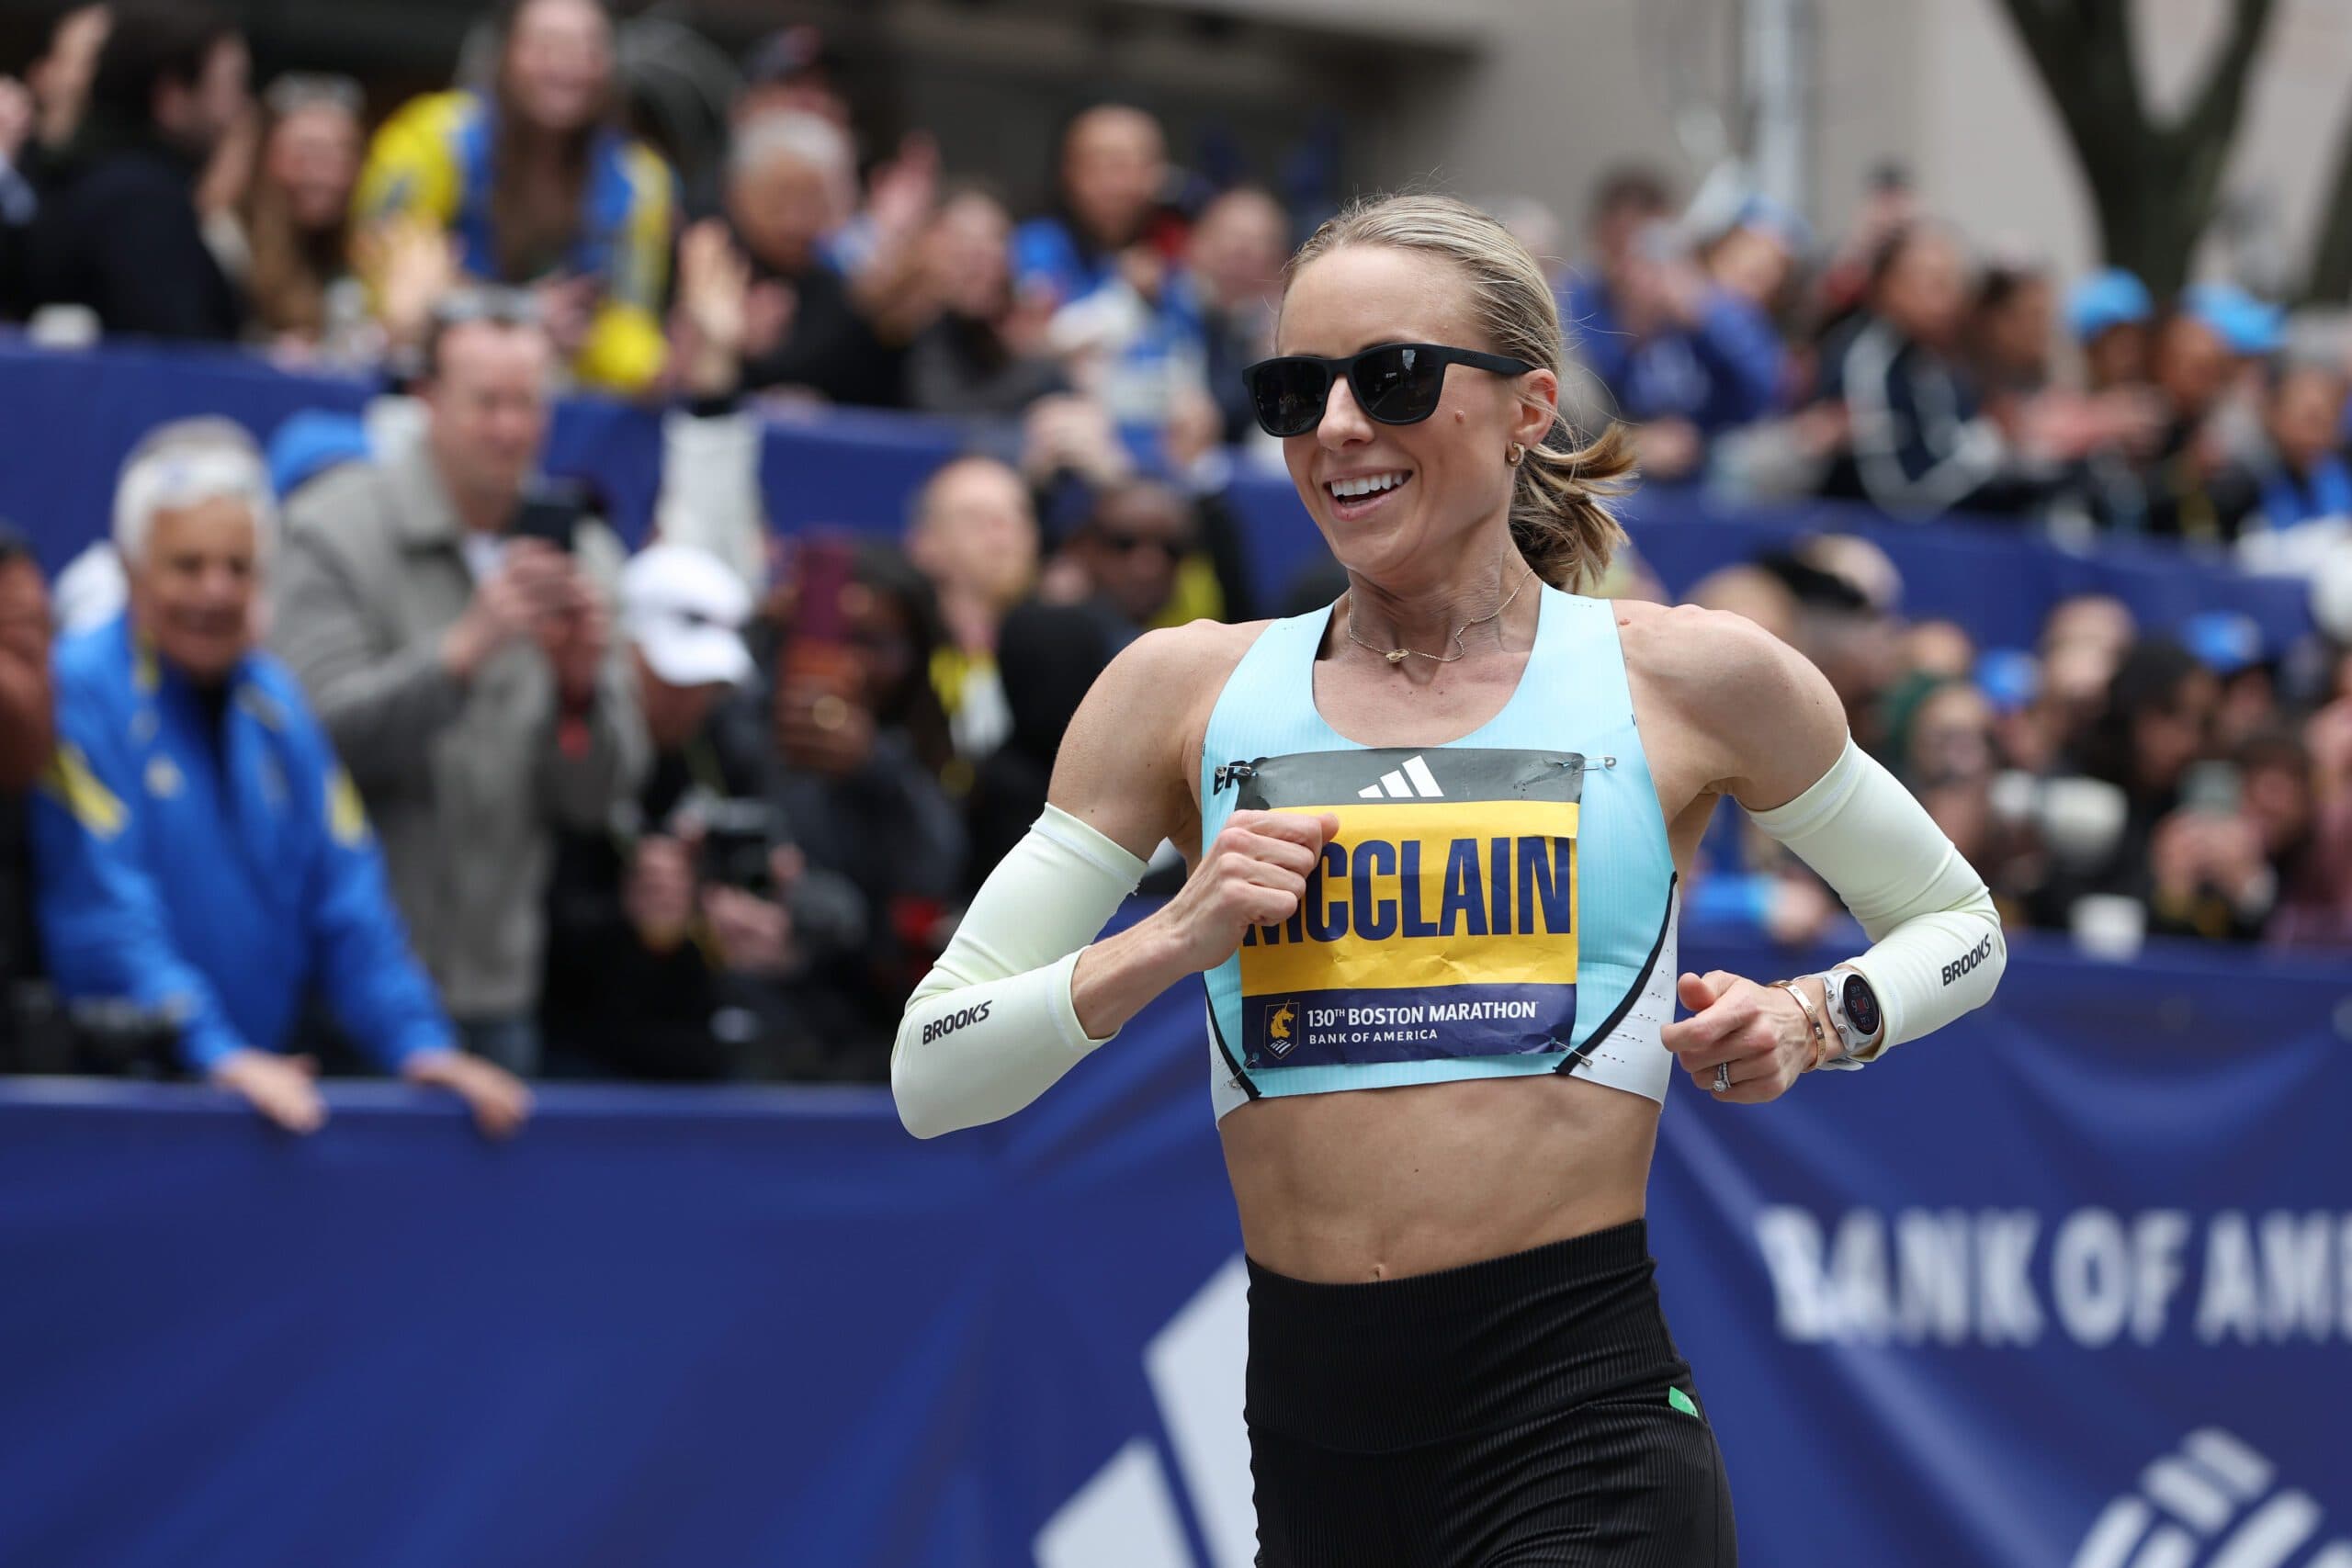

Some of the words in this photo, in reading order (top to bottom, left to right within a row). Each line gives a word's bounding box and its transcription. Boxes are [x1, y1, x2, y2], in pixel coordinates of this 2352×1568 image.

[1243, 836, 1571, 947] CCLAIN
[1941, 933, 1991, 987] BROOKS
[922, 1000, 992, 1044] BROOKS
[1307, 1009, 1345, 1027] 130TH
[1348, 1006, 1423, 1025] BOSTON
[1429, 1001, 1536, 1021] MARATHON
[1309, 1032, 1346, 1044] BANK
[1351, 1032, 1368, 1043] OF
[1374, 1029, 1438, 1043] AMERICA
[2051, 1205, 2192, 1348] OF
[2194, 1208, 2352, 1347] AM
